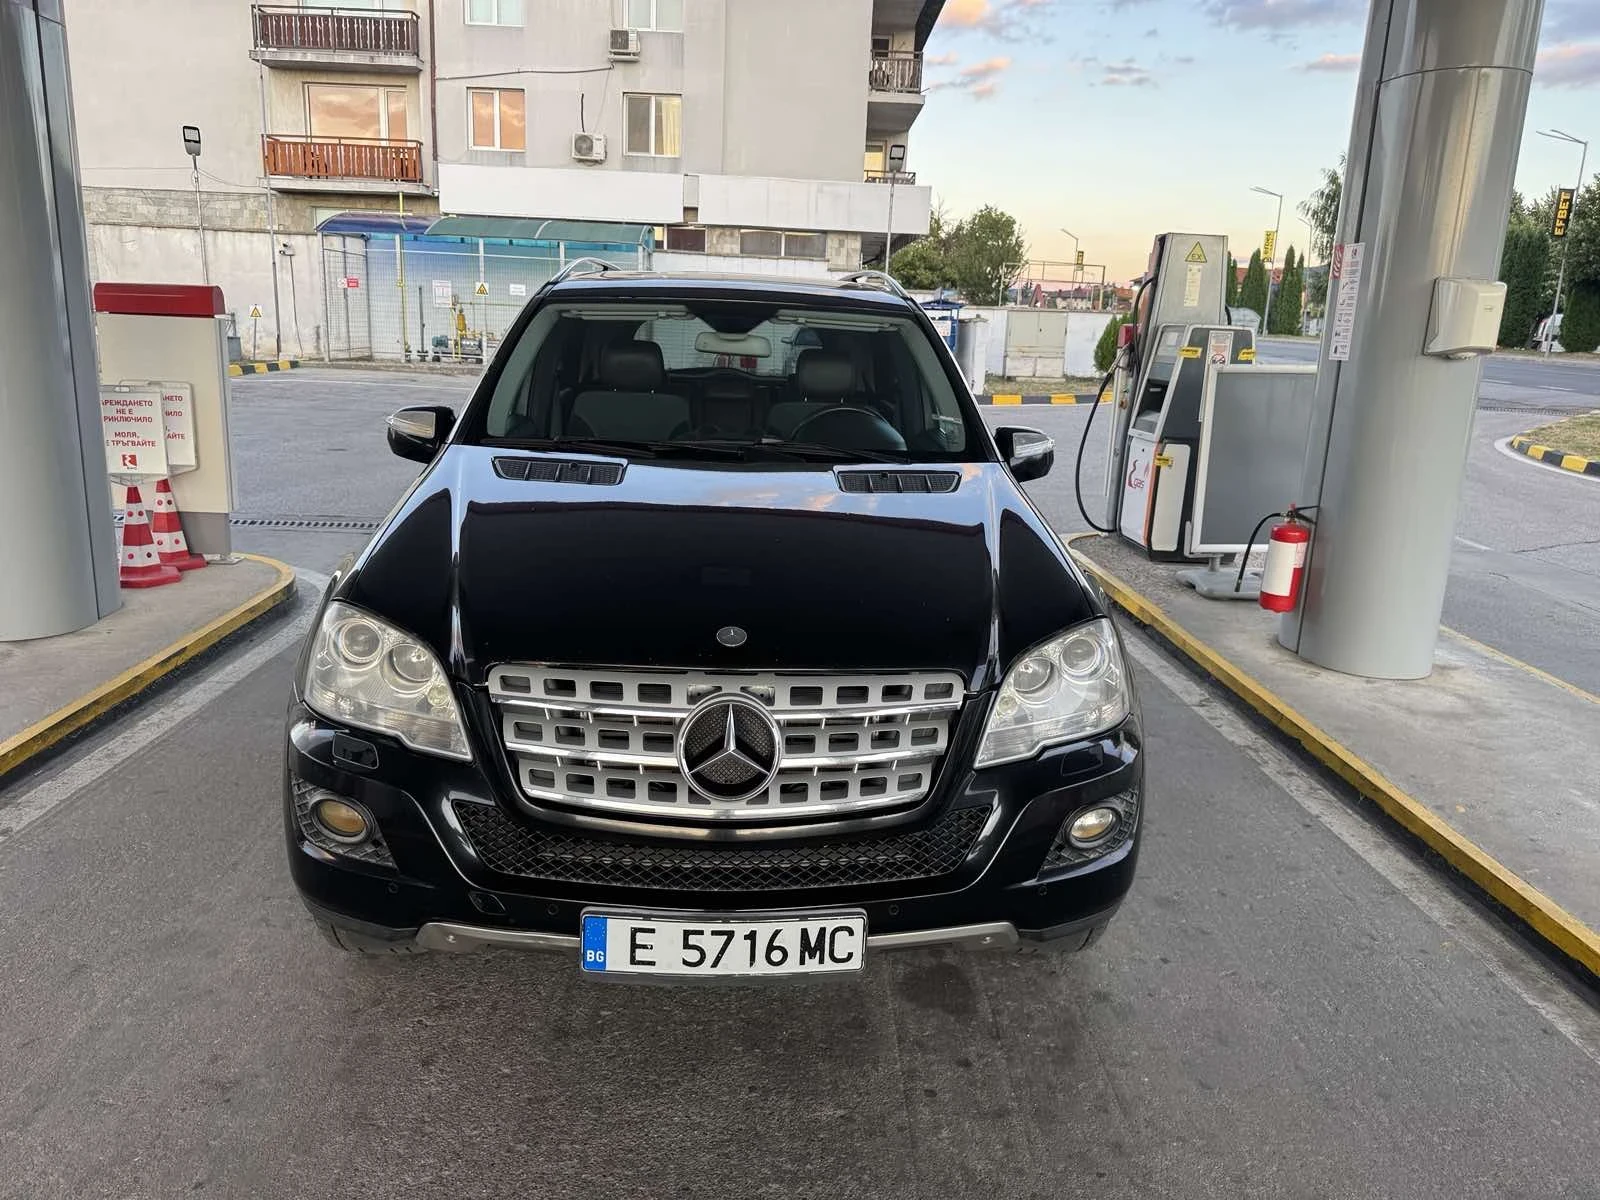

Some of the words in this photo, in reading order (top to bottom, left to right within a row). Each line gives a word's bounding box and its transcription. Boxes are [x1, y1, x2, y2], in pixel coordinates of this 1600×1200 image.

[1554, 191, 1570, 235] EFBET
[114, 431, 140, 439] МОЛЯ,
[111, 439, 156, 447] ТРЪГВАЙТЕ
[630, 927, 656, 966] E
[682, 928, 789, 968] 5716
[799, 926, 855, 966] MC
[586, 951, 604, 963] BG
